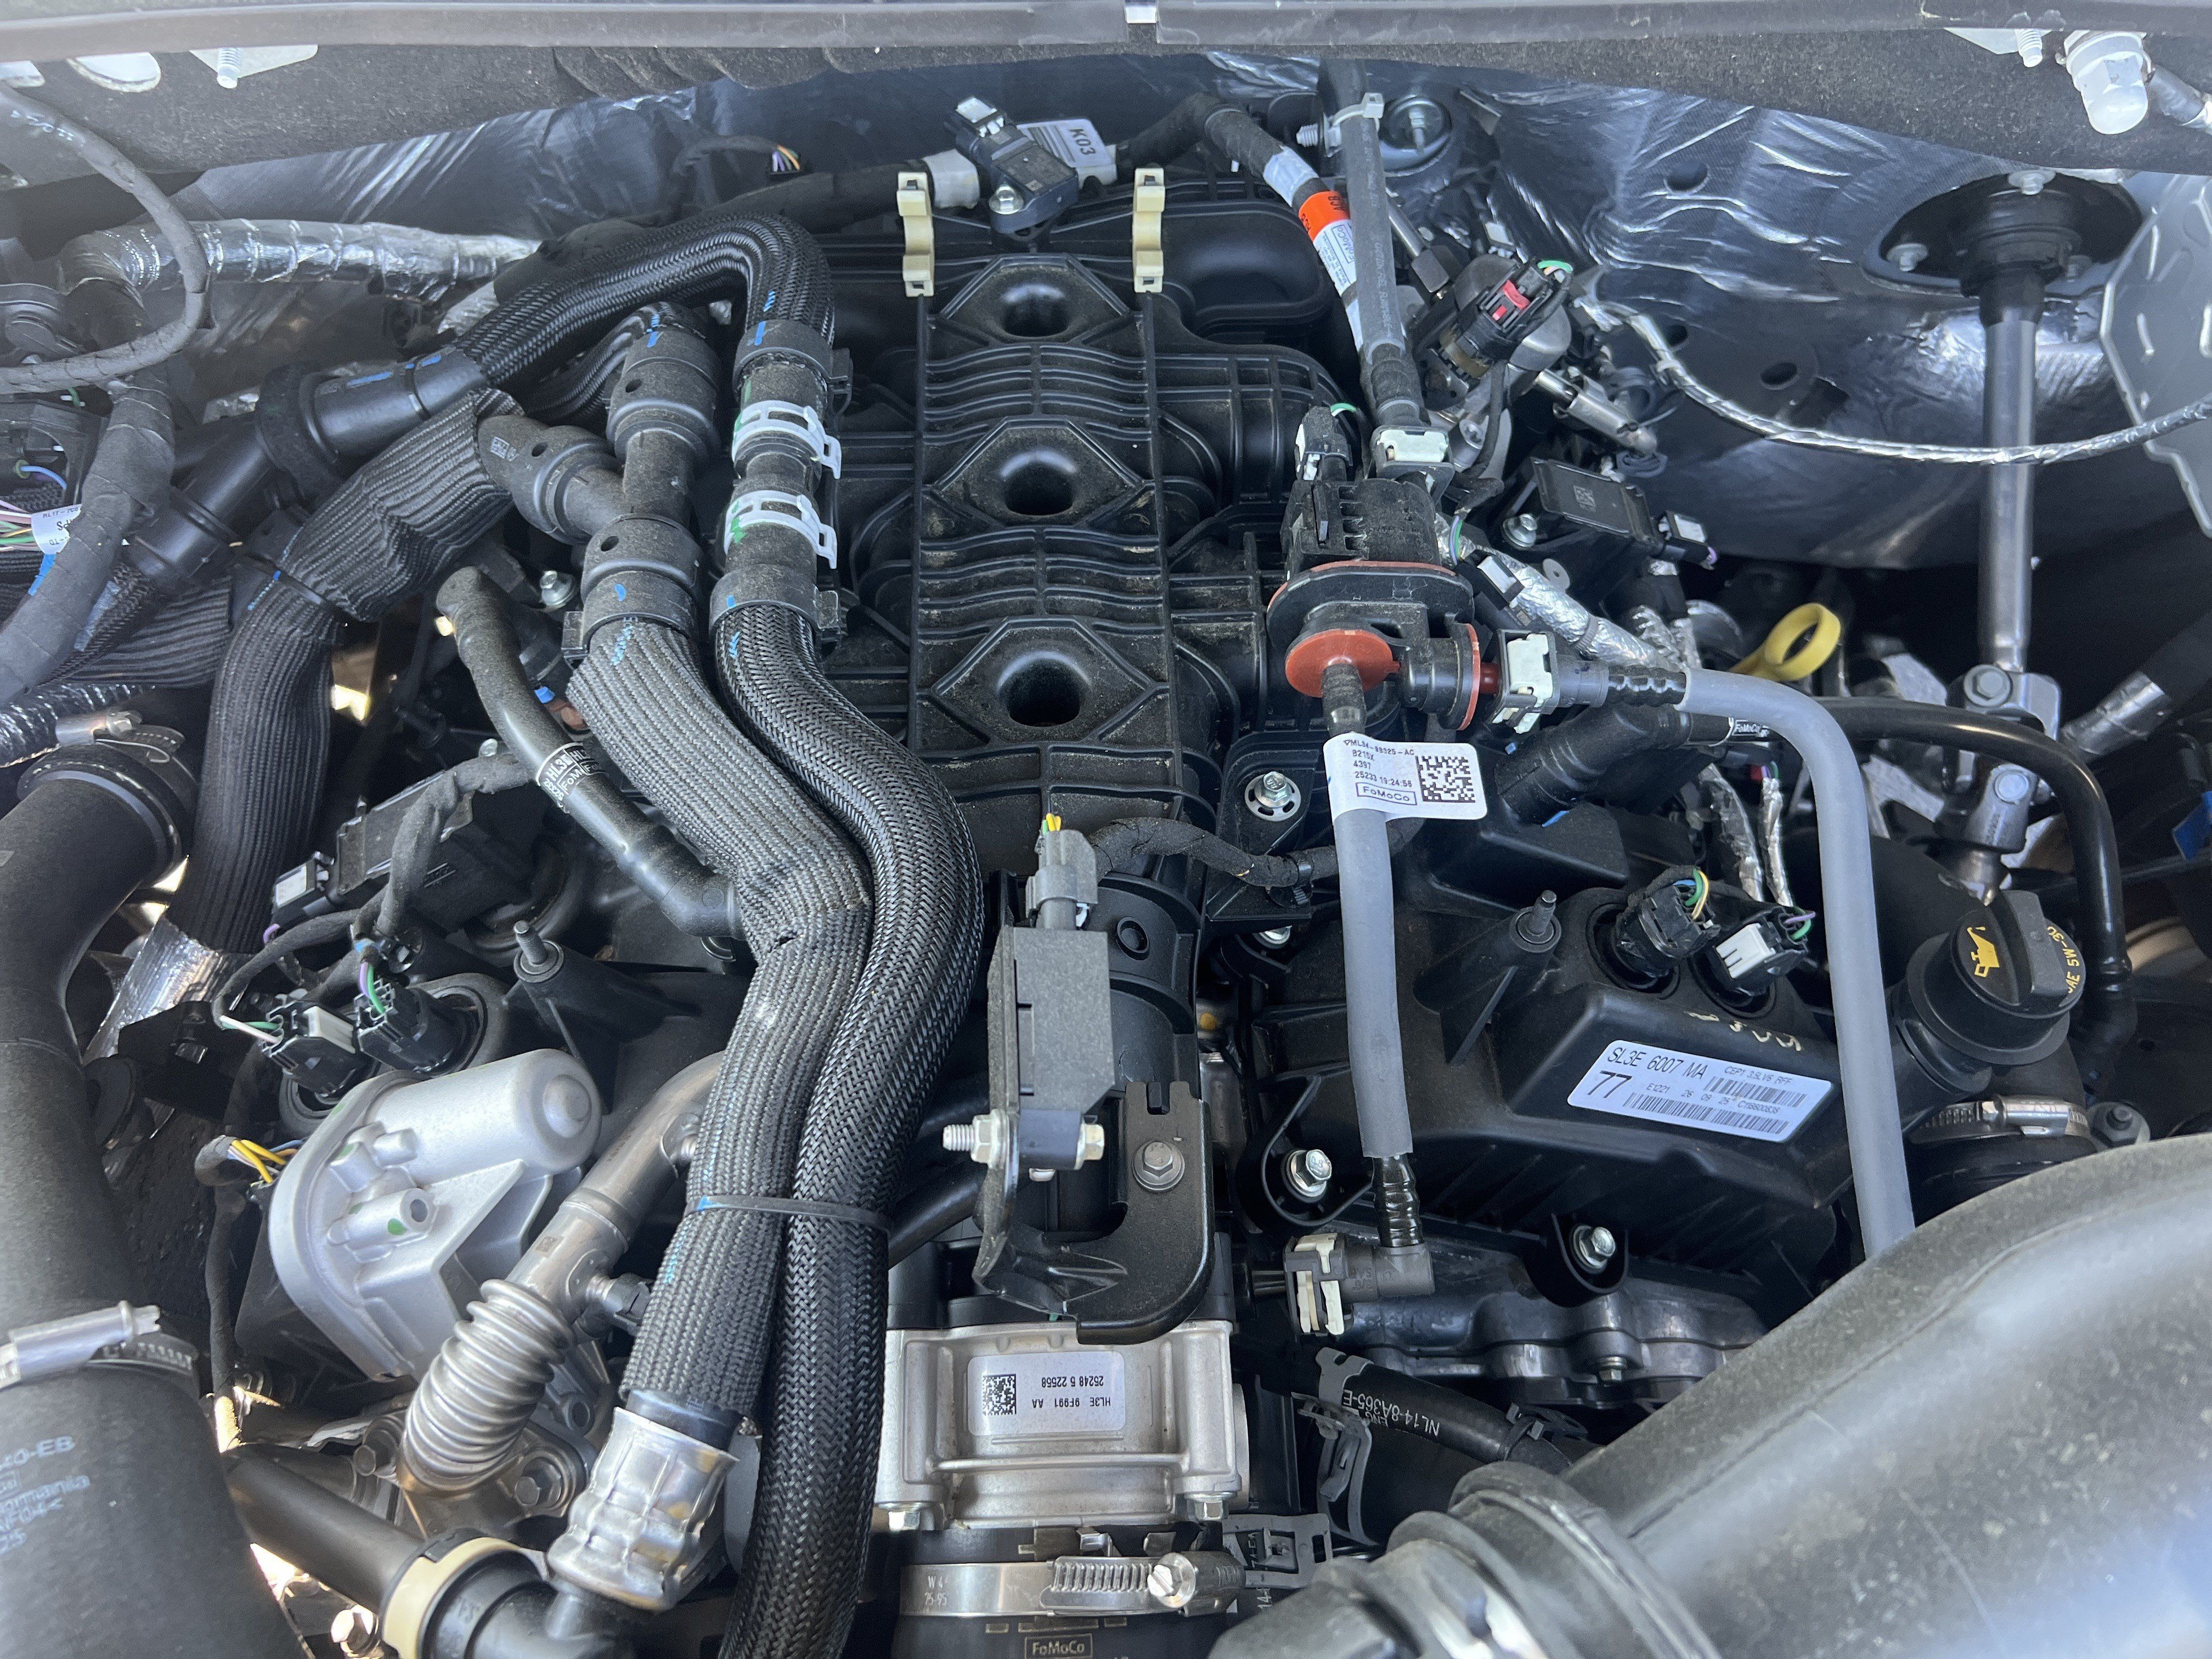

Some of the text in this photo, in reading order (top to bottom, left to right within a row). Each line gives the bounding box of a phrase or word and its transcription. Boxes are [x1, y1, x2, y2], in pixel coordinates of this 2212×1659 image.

[1067, 128, 1096, 155] K03
[1362, 786, 1410, 802] FoMoCo
[1607, 1046, 1647, 1068] SL3E
[1647, 1054, 1683, 1075] 6007
[1683, 1061, 1708, 1080] MA
[1587, 1069, 1633, 1099] 77
[1041, 1376, 1068, 1387] 22558
[1079, 1375, 1104, 1386] 25248
[1032, 1396, 1111, 1408] HL3E 9F991 AA
[1032, 1640, 1085, 1655] FoMoCo
